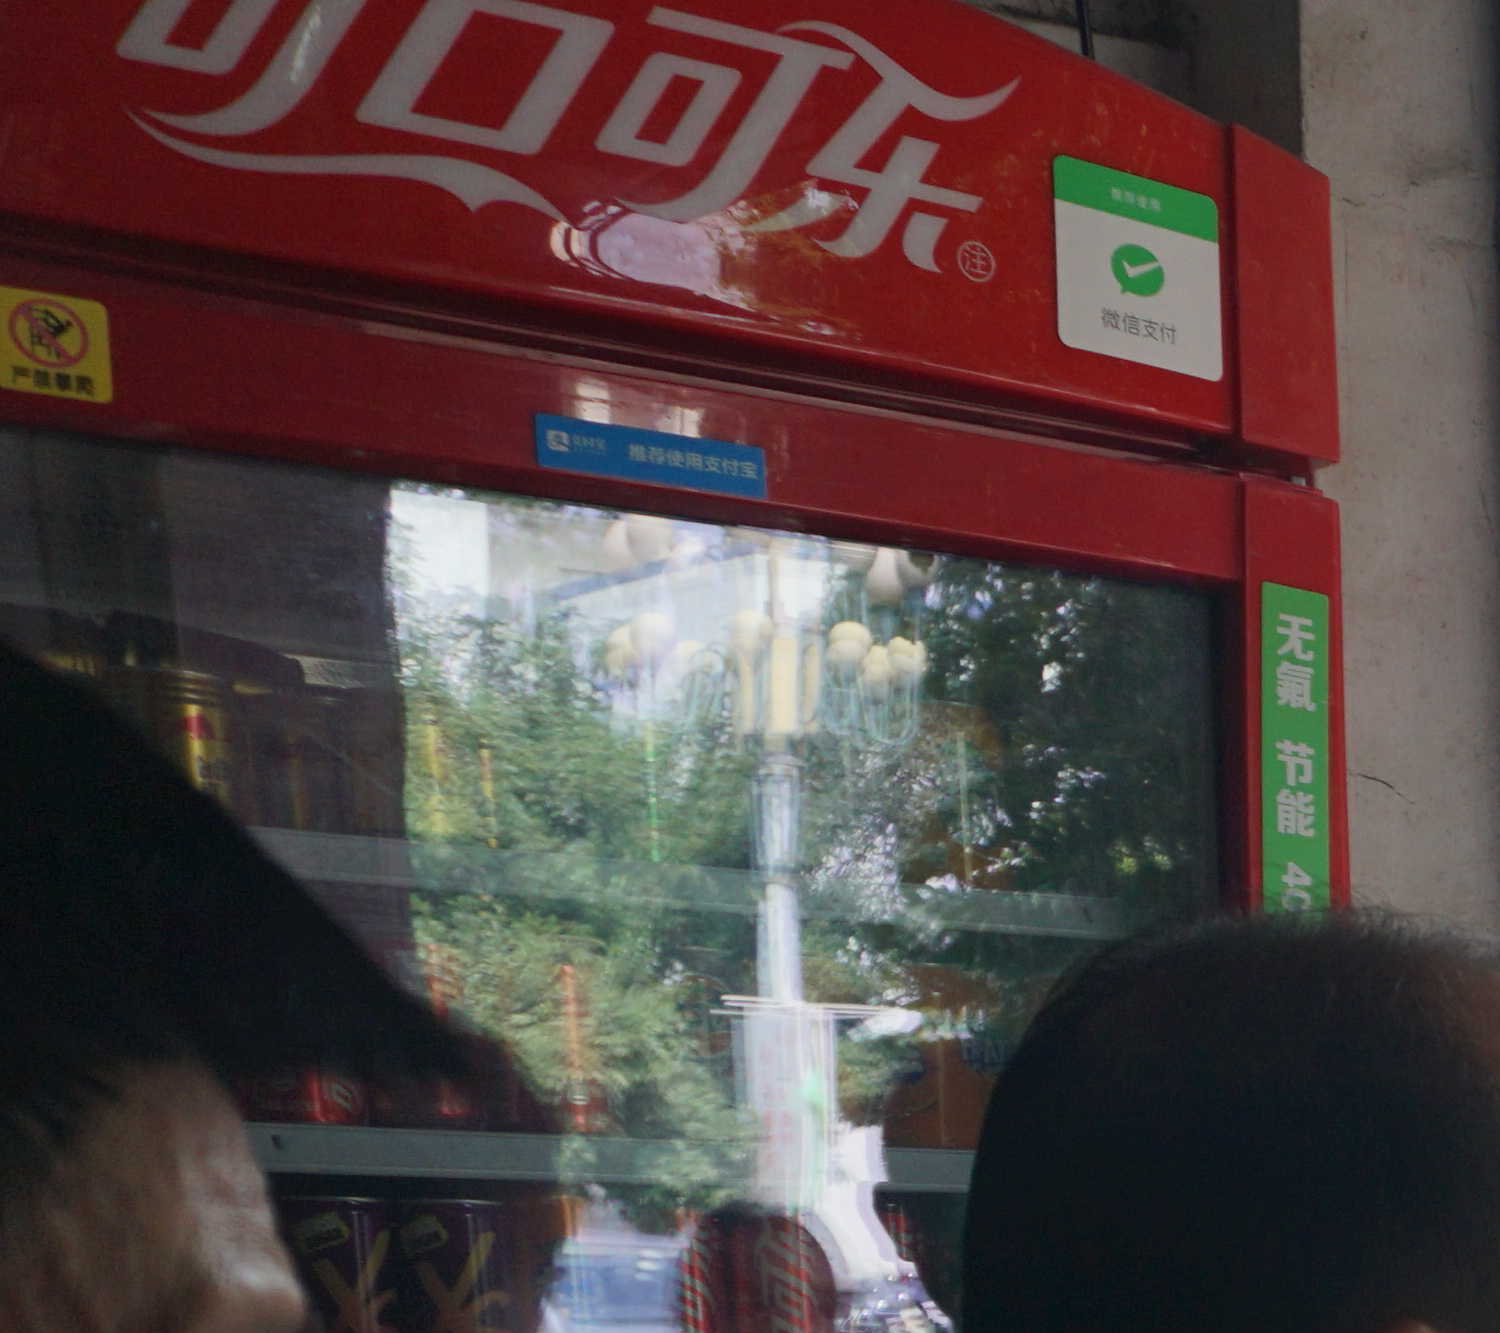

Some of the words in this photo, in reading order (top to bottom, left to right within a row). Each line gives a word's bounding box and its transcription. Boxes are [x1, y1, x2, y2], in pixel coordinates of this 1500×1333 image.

[1100, 307, 1177, 345] 微信支付
[628, 443, 759, 480] 推荐使用支付宝
[1275, 612, 1317, 713] 无氟
[1274, 738, 1316, 838] 节能
